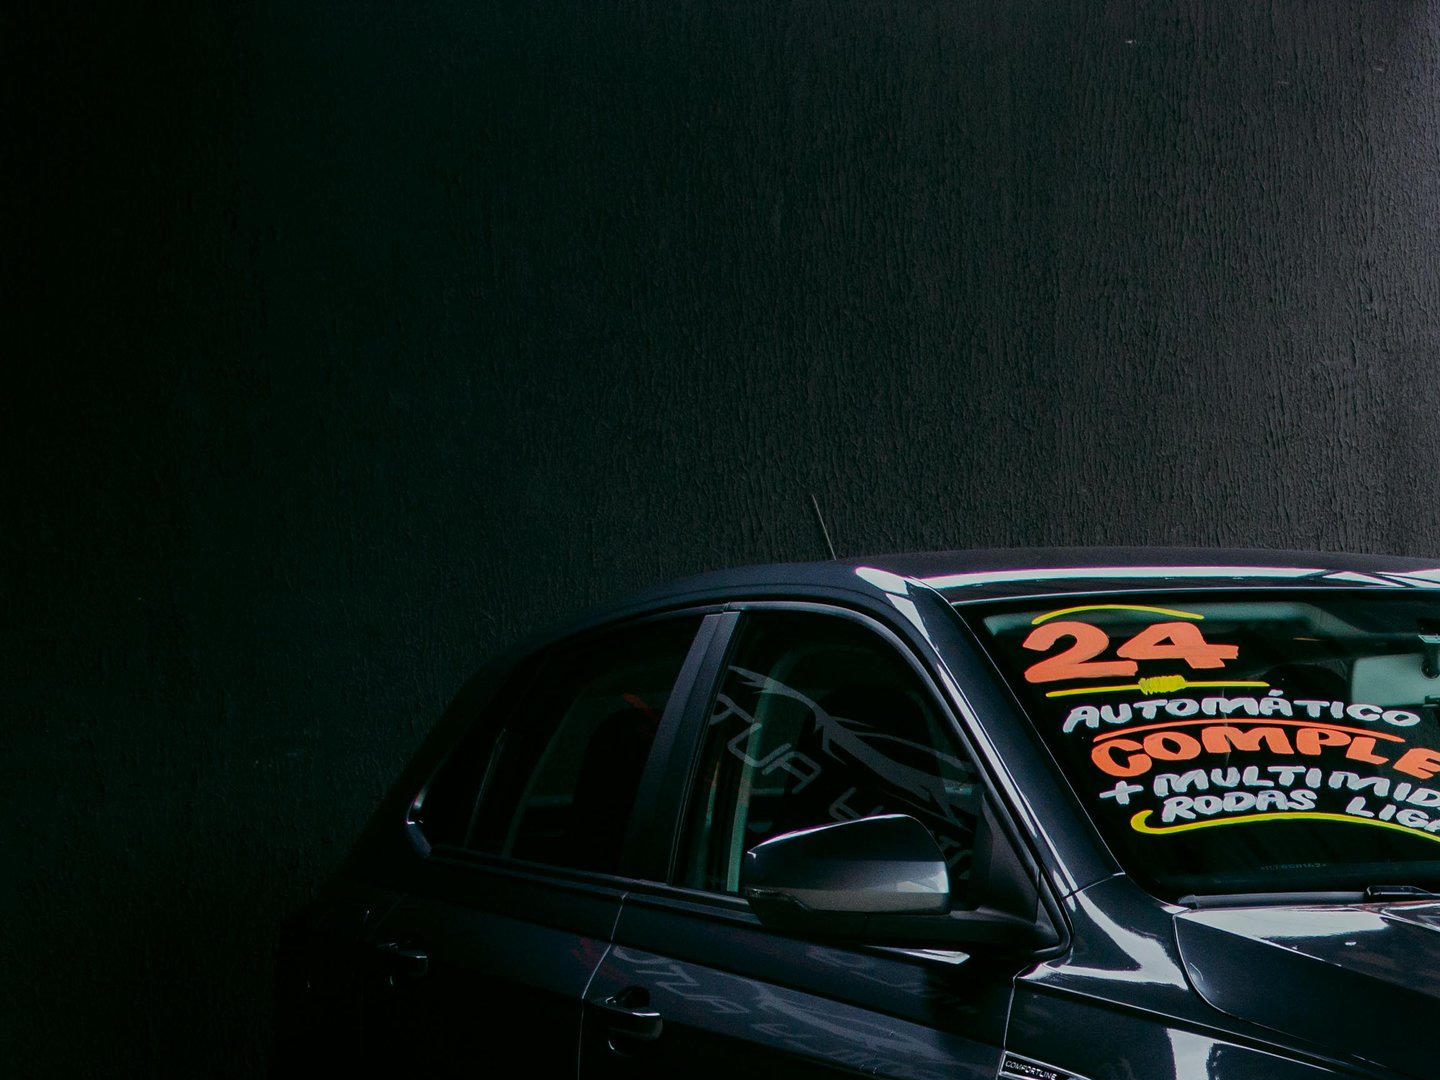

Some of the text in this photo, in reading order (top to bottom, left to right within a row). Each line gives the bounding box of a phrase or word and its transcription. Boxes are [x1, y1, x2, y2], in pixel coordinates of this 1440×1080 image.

[1022, 621, 1239, 683] 24
[1062, 689, 1420, 733] AUTOMÁTICO
[1161, 789, 1317, 823] RODAS
[1005, 1061, 1057, 1080] COMFORTLINE
